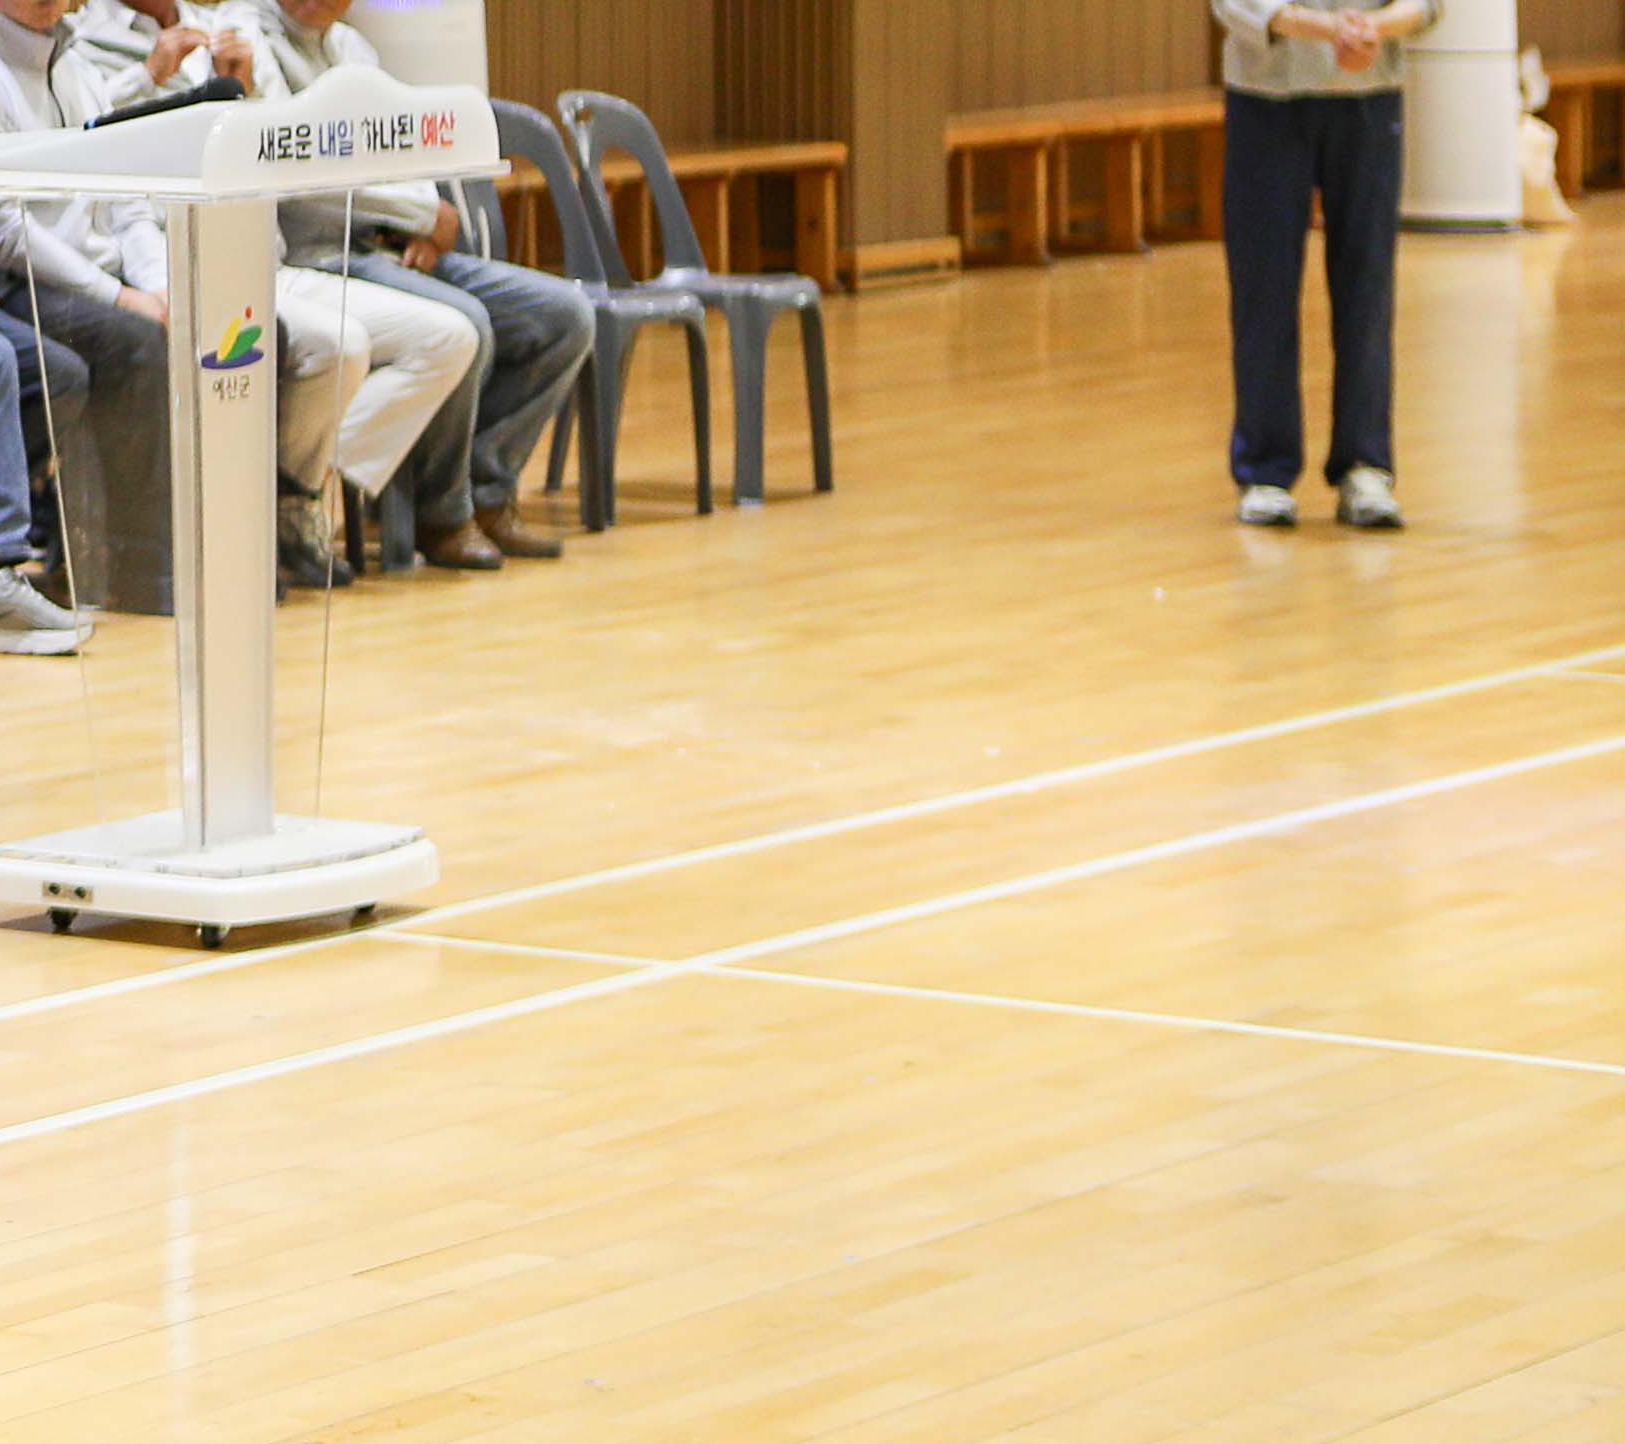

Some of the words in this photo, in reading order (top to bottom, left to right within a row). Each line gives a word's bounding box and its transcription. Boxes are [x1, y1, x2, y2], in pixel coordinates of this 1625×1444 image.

[258, 124, 312, 161] 새로운
[319, 120, 354, 156] 내일
[362, 113, 413, 152] 하나된
[421, 110, 455, 147] 예산
[214, 376, 249, 401] 예산군
